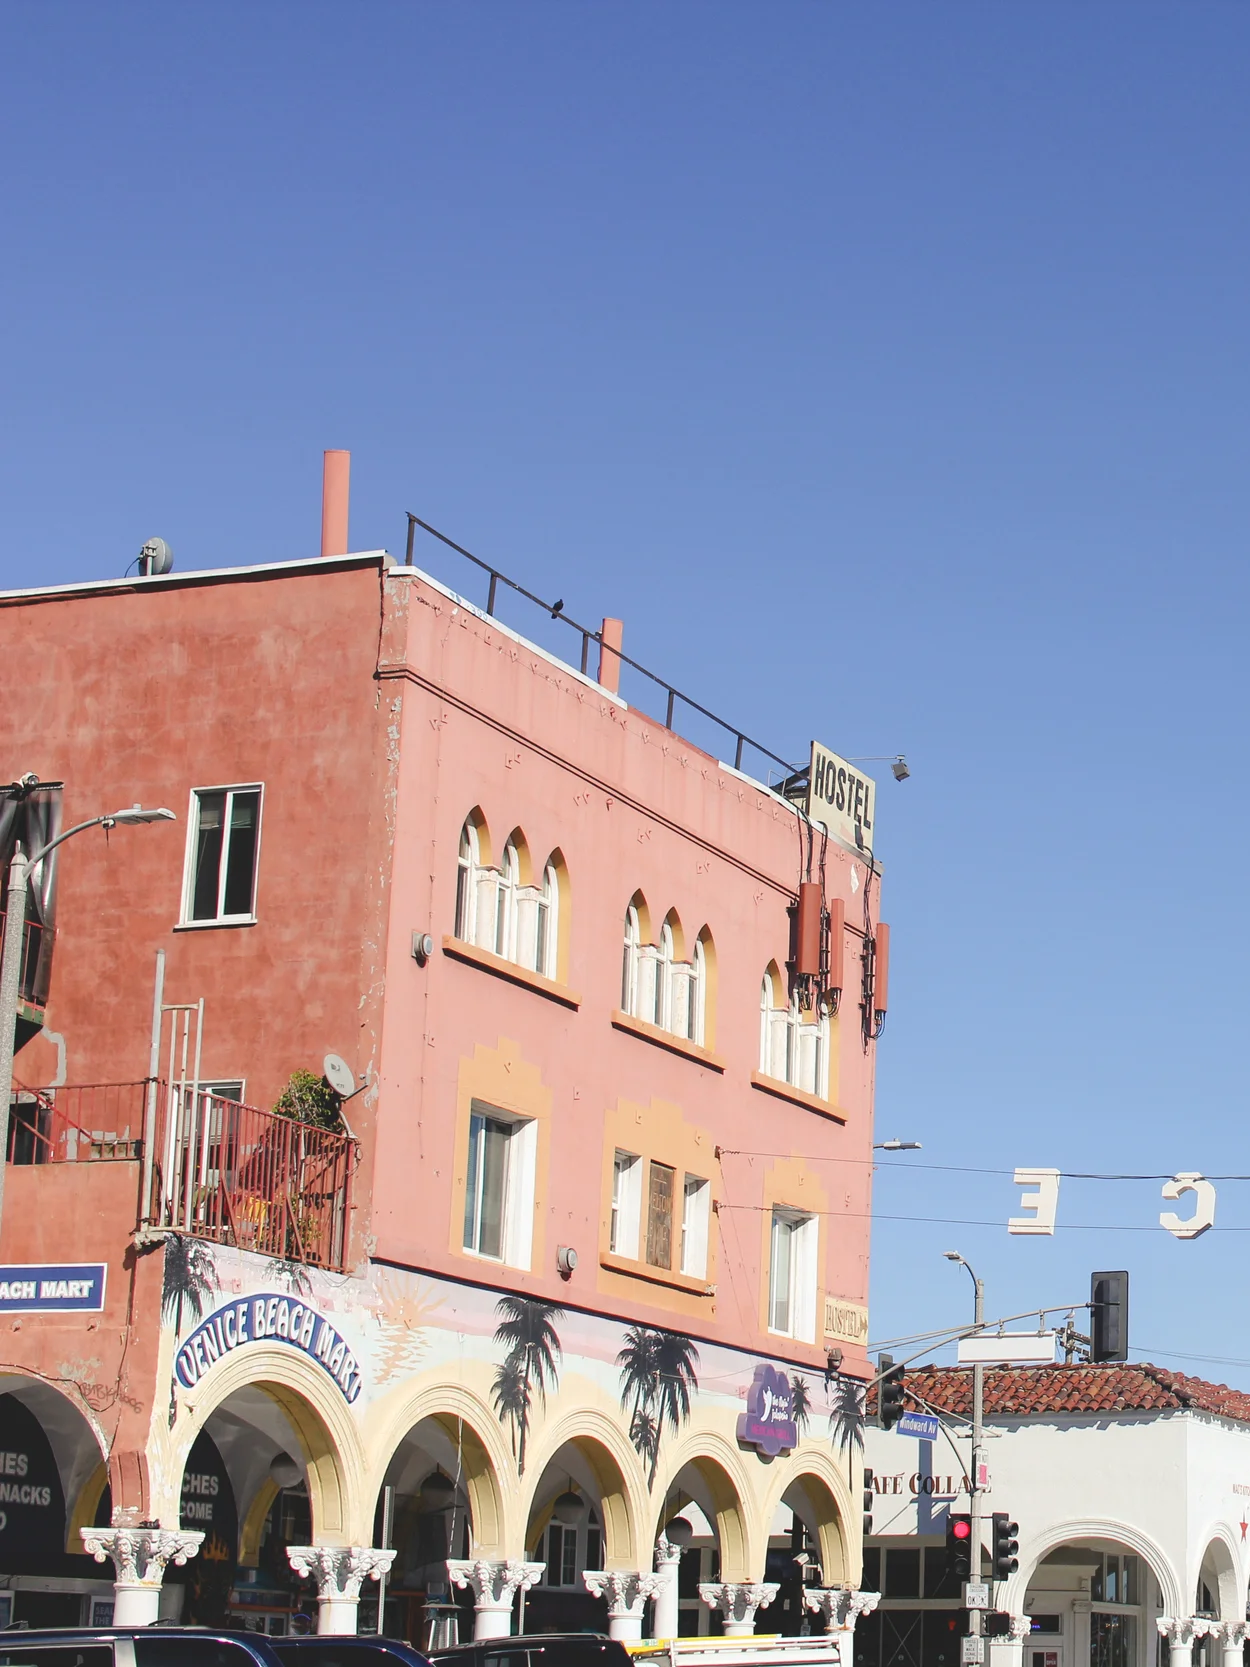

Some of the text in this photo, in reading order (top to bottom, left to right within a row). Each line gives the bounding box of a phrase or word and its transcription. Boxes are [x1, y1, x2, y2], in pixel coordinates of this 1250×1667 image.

[814, 752, 871, 830] HOSTEL
[0, 1280, 94, 1299] ACH MART
[825, 1304, 859, 1338] HOSTEL
[178, 1297, 362, 1402] VENICE BEACH MART
[899, 1416, 936, 1434] Windward Av
[0, 1483, 51, 1506] NACKS
[870, 1472, 903, 1495] AFÉ
[909, 1473, 992, 1495] COLLA
[968, 1596, 976, 1605] OK
